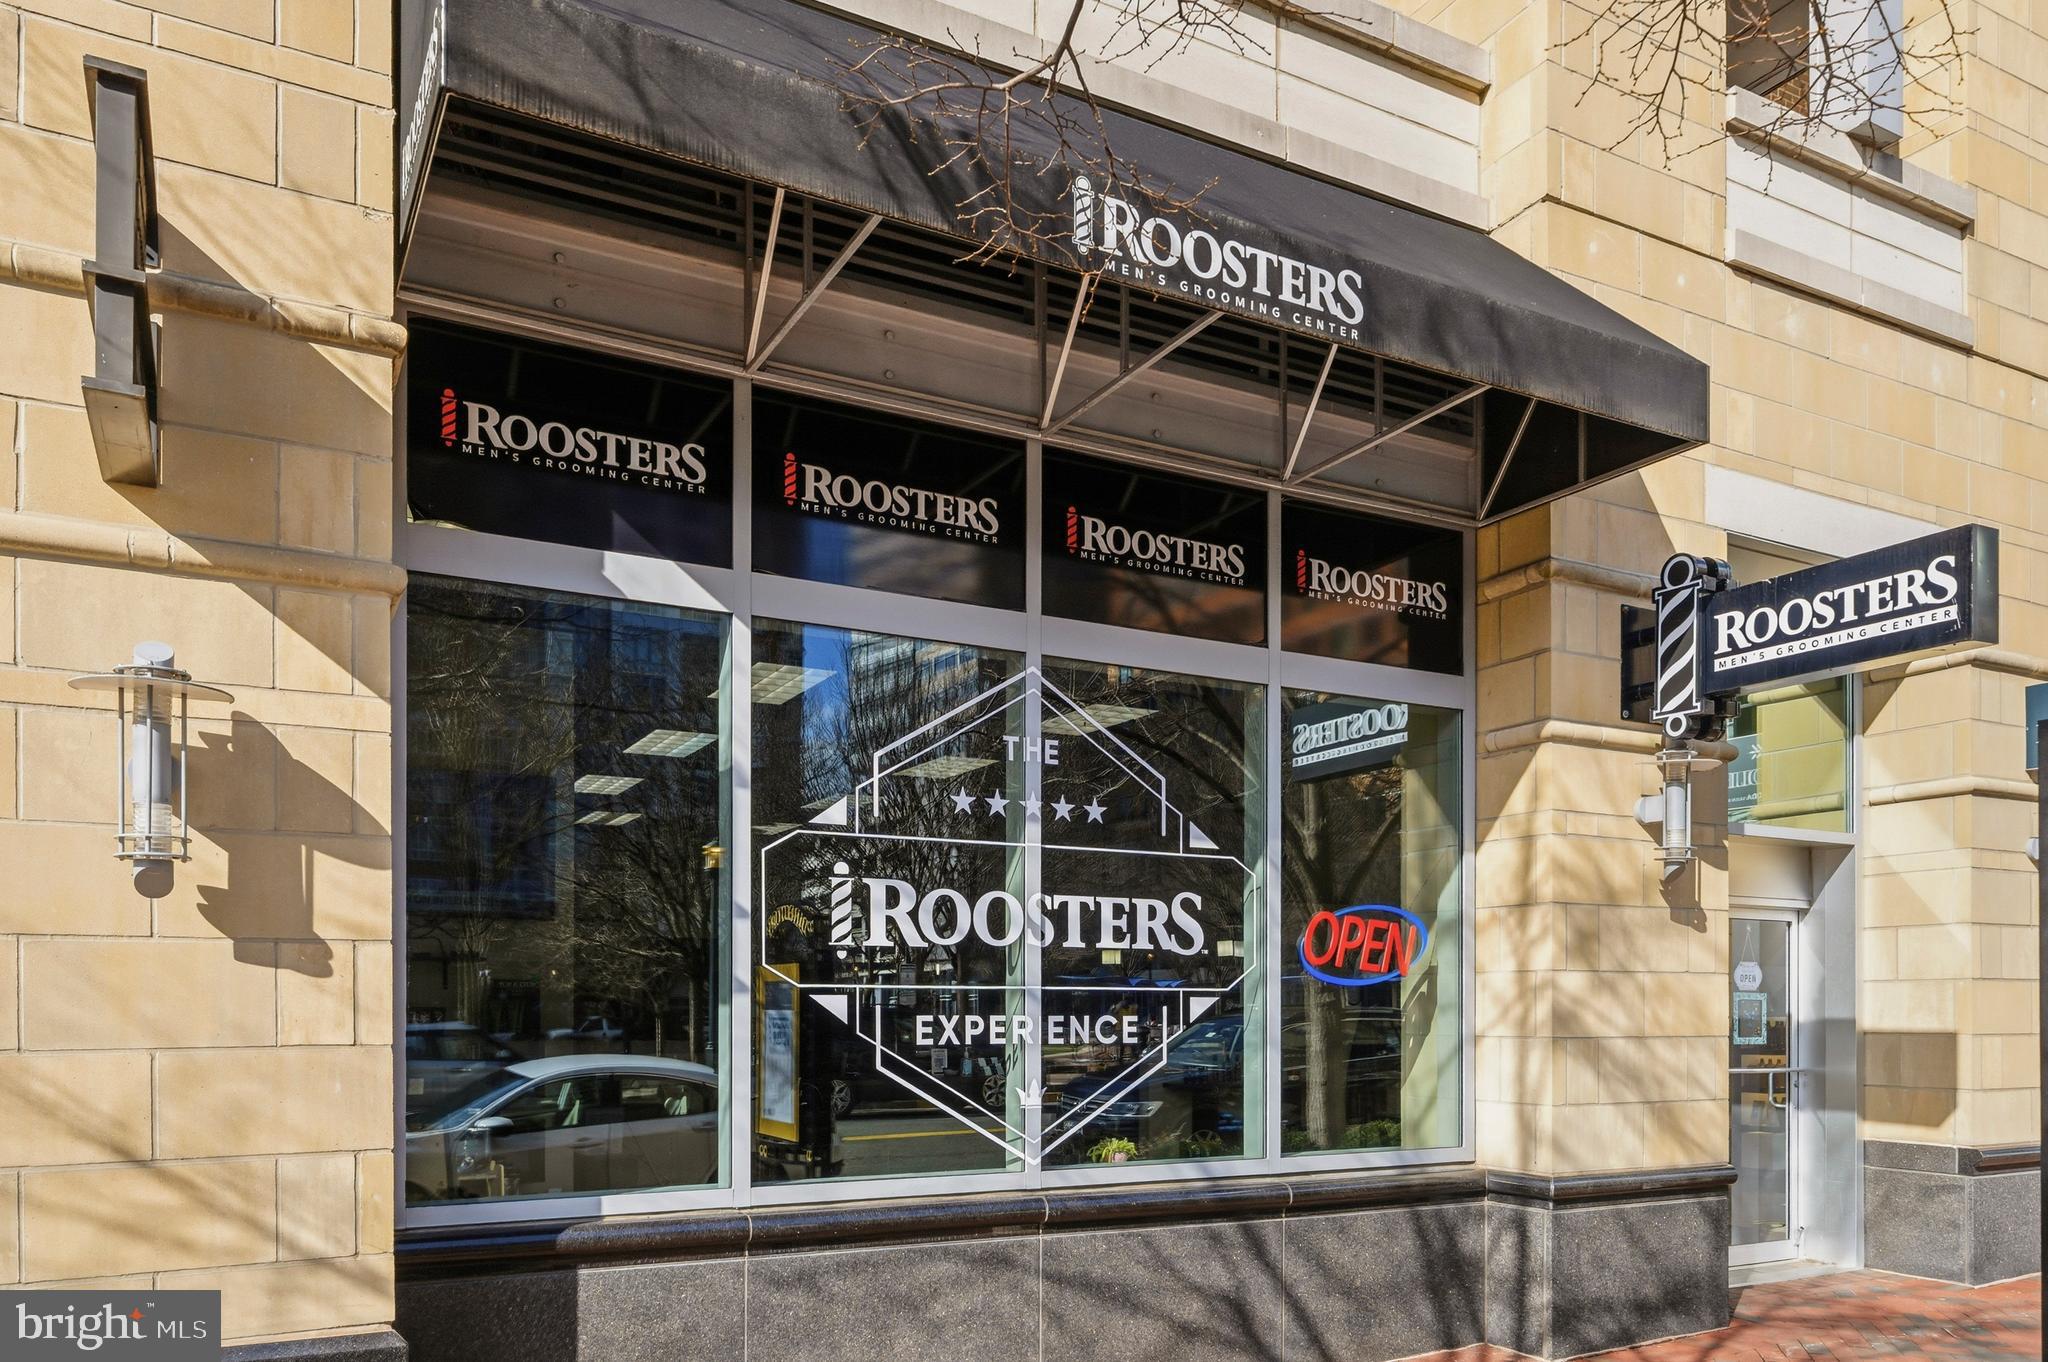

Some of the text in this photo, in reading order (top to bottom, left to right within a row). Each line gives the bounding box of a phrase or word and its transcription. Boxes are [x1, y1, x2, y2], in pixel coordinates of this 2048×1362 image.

[1098, 193, 1364, 325] ROOSTERS
[1105, 259, 1359, 341] MEN'S GROOMING CENTER
[461, 444, 705, 494] MEN'S GROOMING CENTER
[462, 400, 707, 484] ROOSTERS
[801, 463, 999, 535] ROOSTERS
[801, 502, 998, 544] MEN'S GROOMING CENTER
[1080, 550, 1244, 586] MEN'S GROOMING CENTER
[1081, 515, 1246, 578] ROOSTERS
[1308, 557, 1448, 613] ROOSTERS
[1308, 590, 1447, 620] MEN'S GROOMING CENTER
[1714, 555, 1958, 655] ROOSTERS
[1718, 609, 1951, 669] MEN'S GROOMING CENTER
[1003, 735, 1059, 765] THE
[862, 877, 1204, 956] ROOSTERS
[1304, 911, 1417, 977] OPEN
[1739, 974, 1757, 983] OPEN
[915, 1015, 1139, 1045] EXPERIENCE
